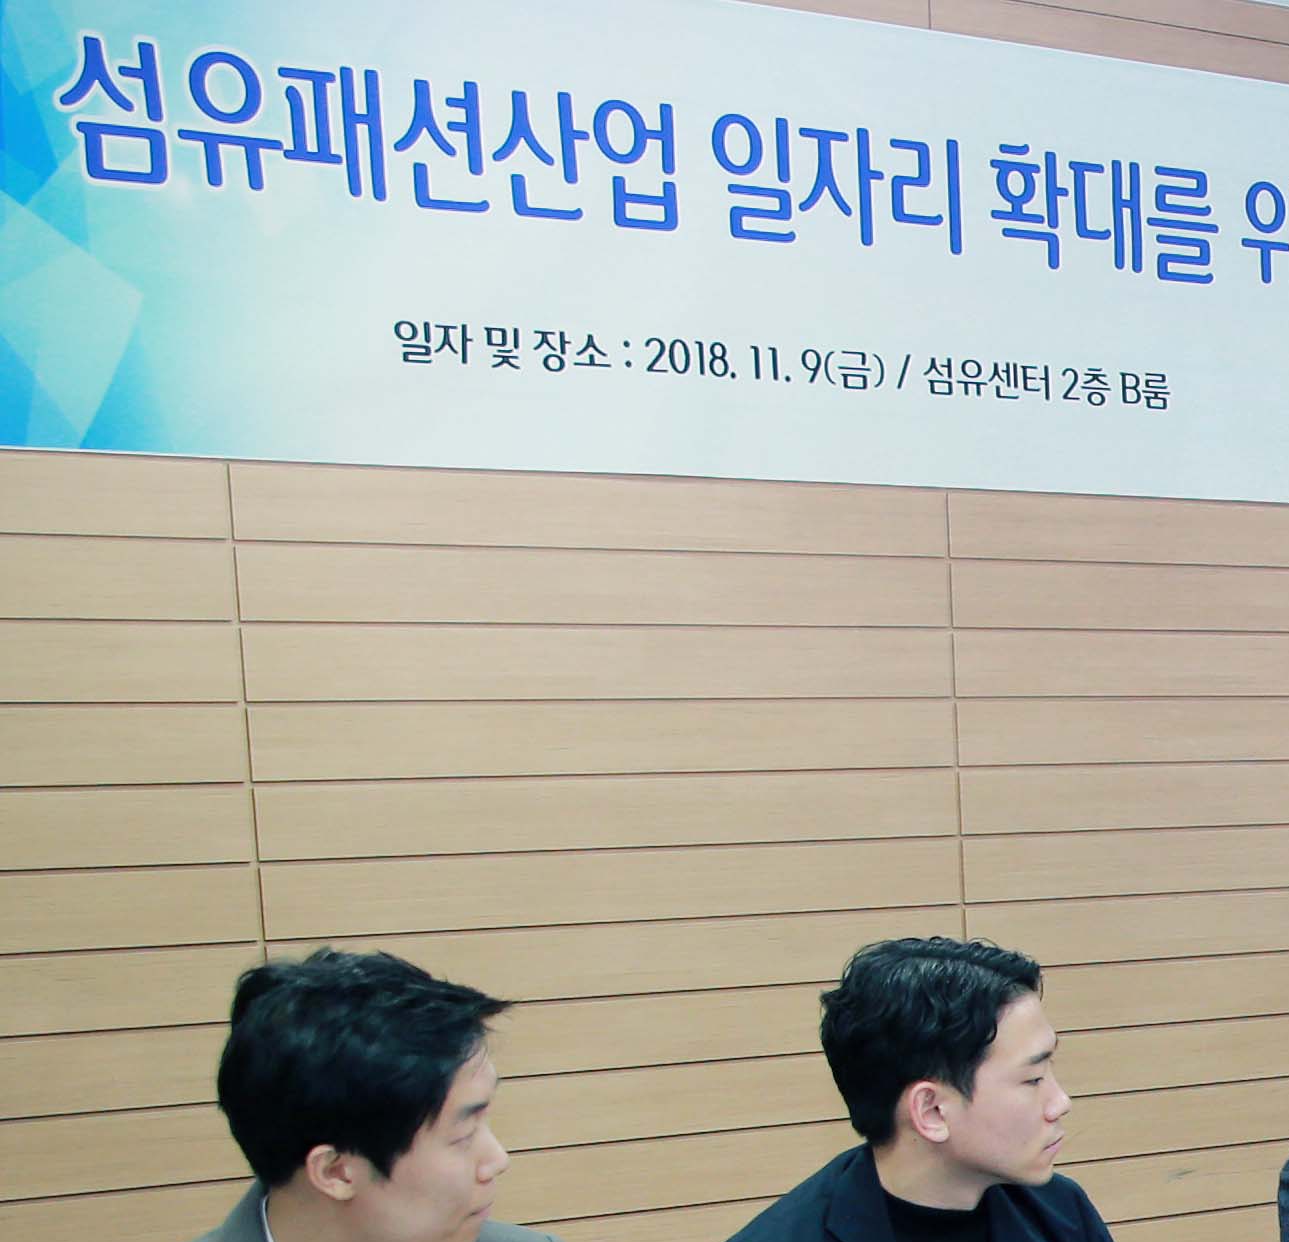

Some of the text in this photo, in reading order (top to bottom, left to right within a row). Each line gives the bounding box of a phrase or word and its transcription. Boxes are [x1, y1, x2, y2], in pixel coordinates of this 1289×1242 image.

[57, 34, 680, 232] 섬유패션산업
[711, 112, 963, 256] 일자리
[988, 142, 1220, 285] 확대를
[393, 320, 473, 365] 일자
[483, 326, 521, 370] 및
[533, 329, 612, 373] 장소
[644, 337, 737, 379] 2018.
[750, 345, 791, 383] 11.
[801, 348, 885, 391] 9(금)
[923, 356, 1050, 401] 섬유센터
[1061, 367, 1111, 407] 2층
[1119, 371, 1171, 410] B룸
